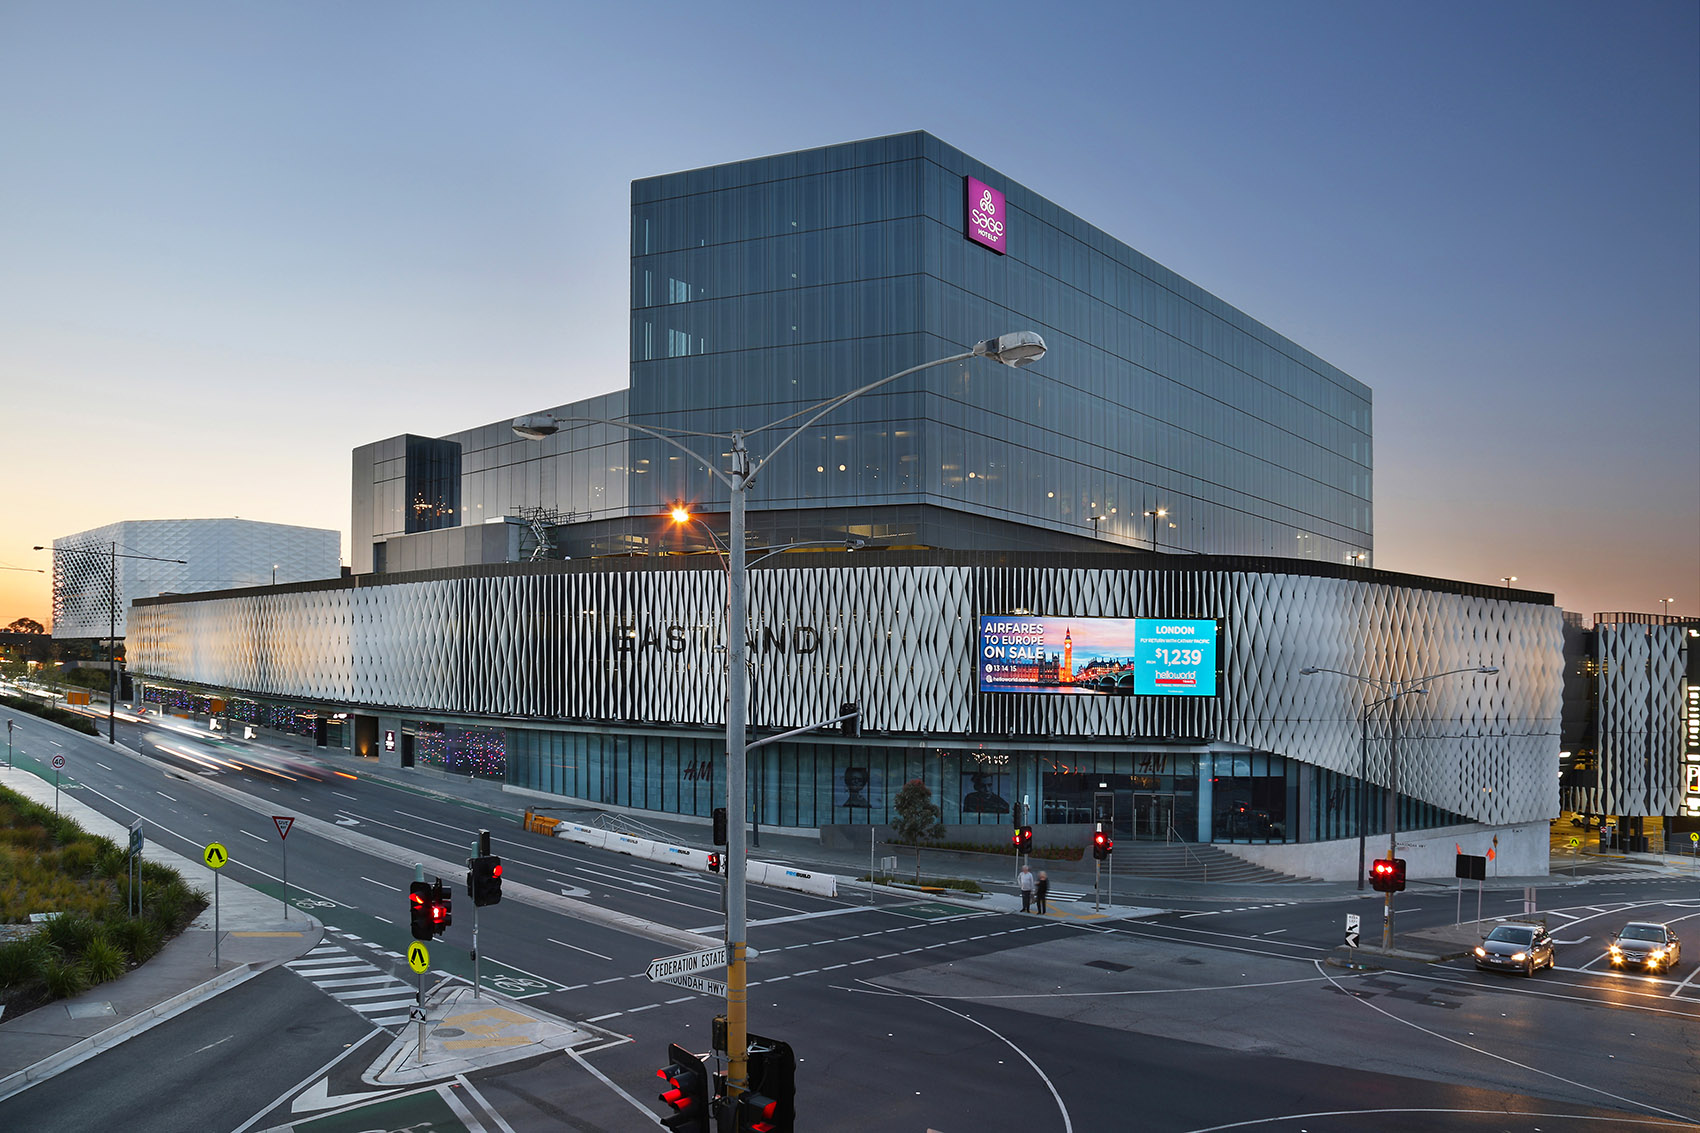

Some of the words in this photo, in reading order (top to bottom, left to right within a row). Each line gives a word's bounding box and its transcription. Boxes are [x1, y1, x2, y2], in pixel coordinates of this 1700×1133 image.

[984, 622, 1044, 634] AIRFARES
[1156, 626, 1195, 634] LONDON
[984, 635, 999, 645] TO
[1002, 635, 1044, 645] EUROPE
[984, 646, 1005, 658] ON
[1009, 646, 1044, 659] SALE
[1155, 670, 1196, 679] helloworld
[655, 956, 698, 977] FEDERATION
[701, 950, 725, 967] ESTATE
[707, 982, 725, 995] HWY
